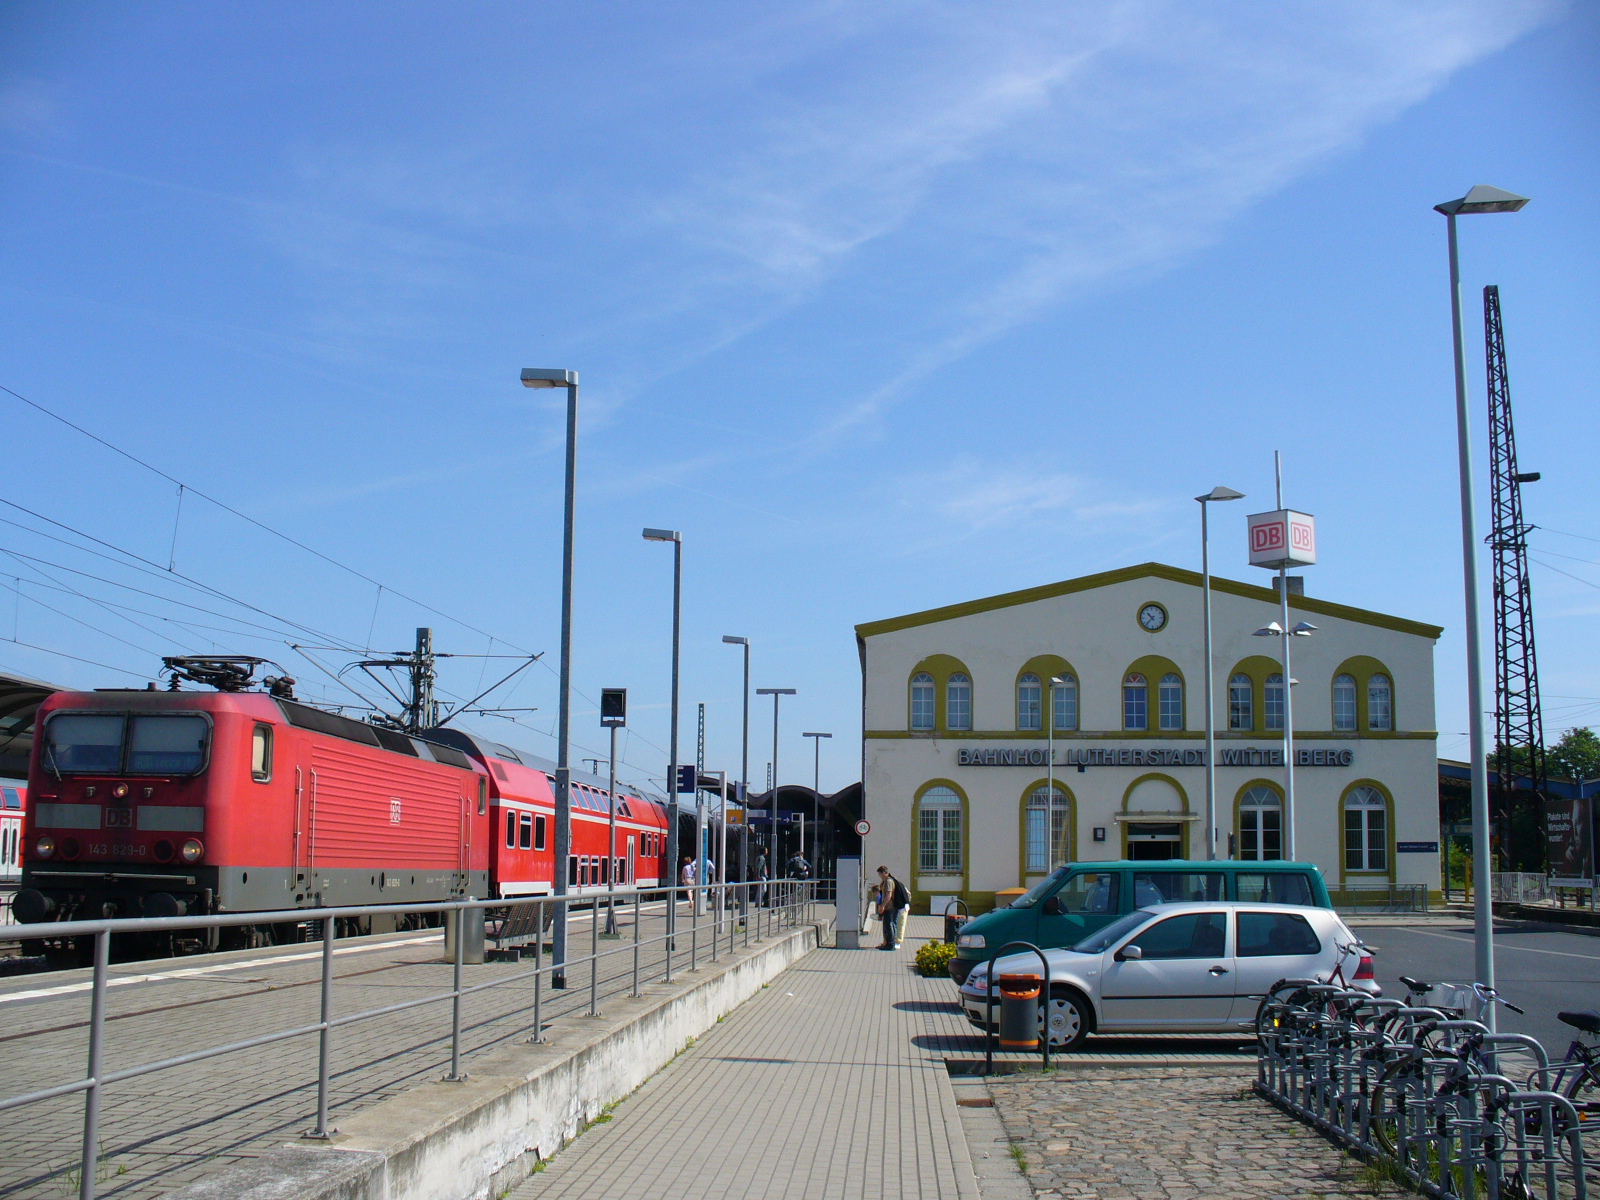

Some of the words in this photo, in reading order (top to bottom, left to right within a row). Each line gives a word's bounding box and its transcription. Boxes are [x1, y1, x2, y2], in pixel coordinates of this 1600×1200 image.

[1255, 525, 1282, 548] DB
[1293, 525, 1311, 548] DB
[1221, 748, 1354, 766] WITTEBERG
[107, 808, 131, 826] DB
[89, 843, 107, 855] 143
[113, 844, 146, 856] 829-0
